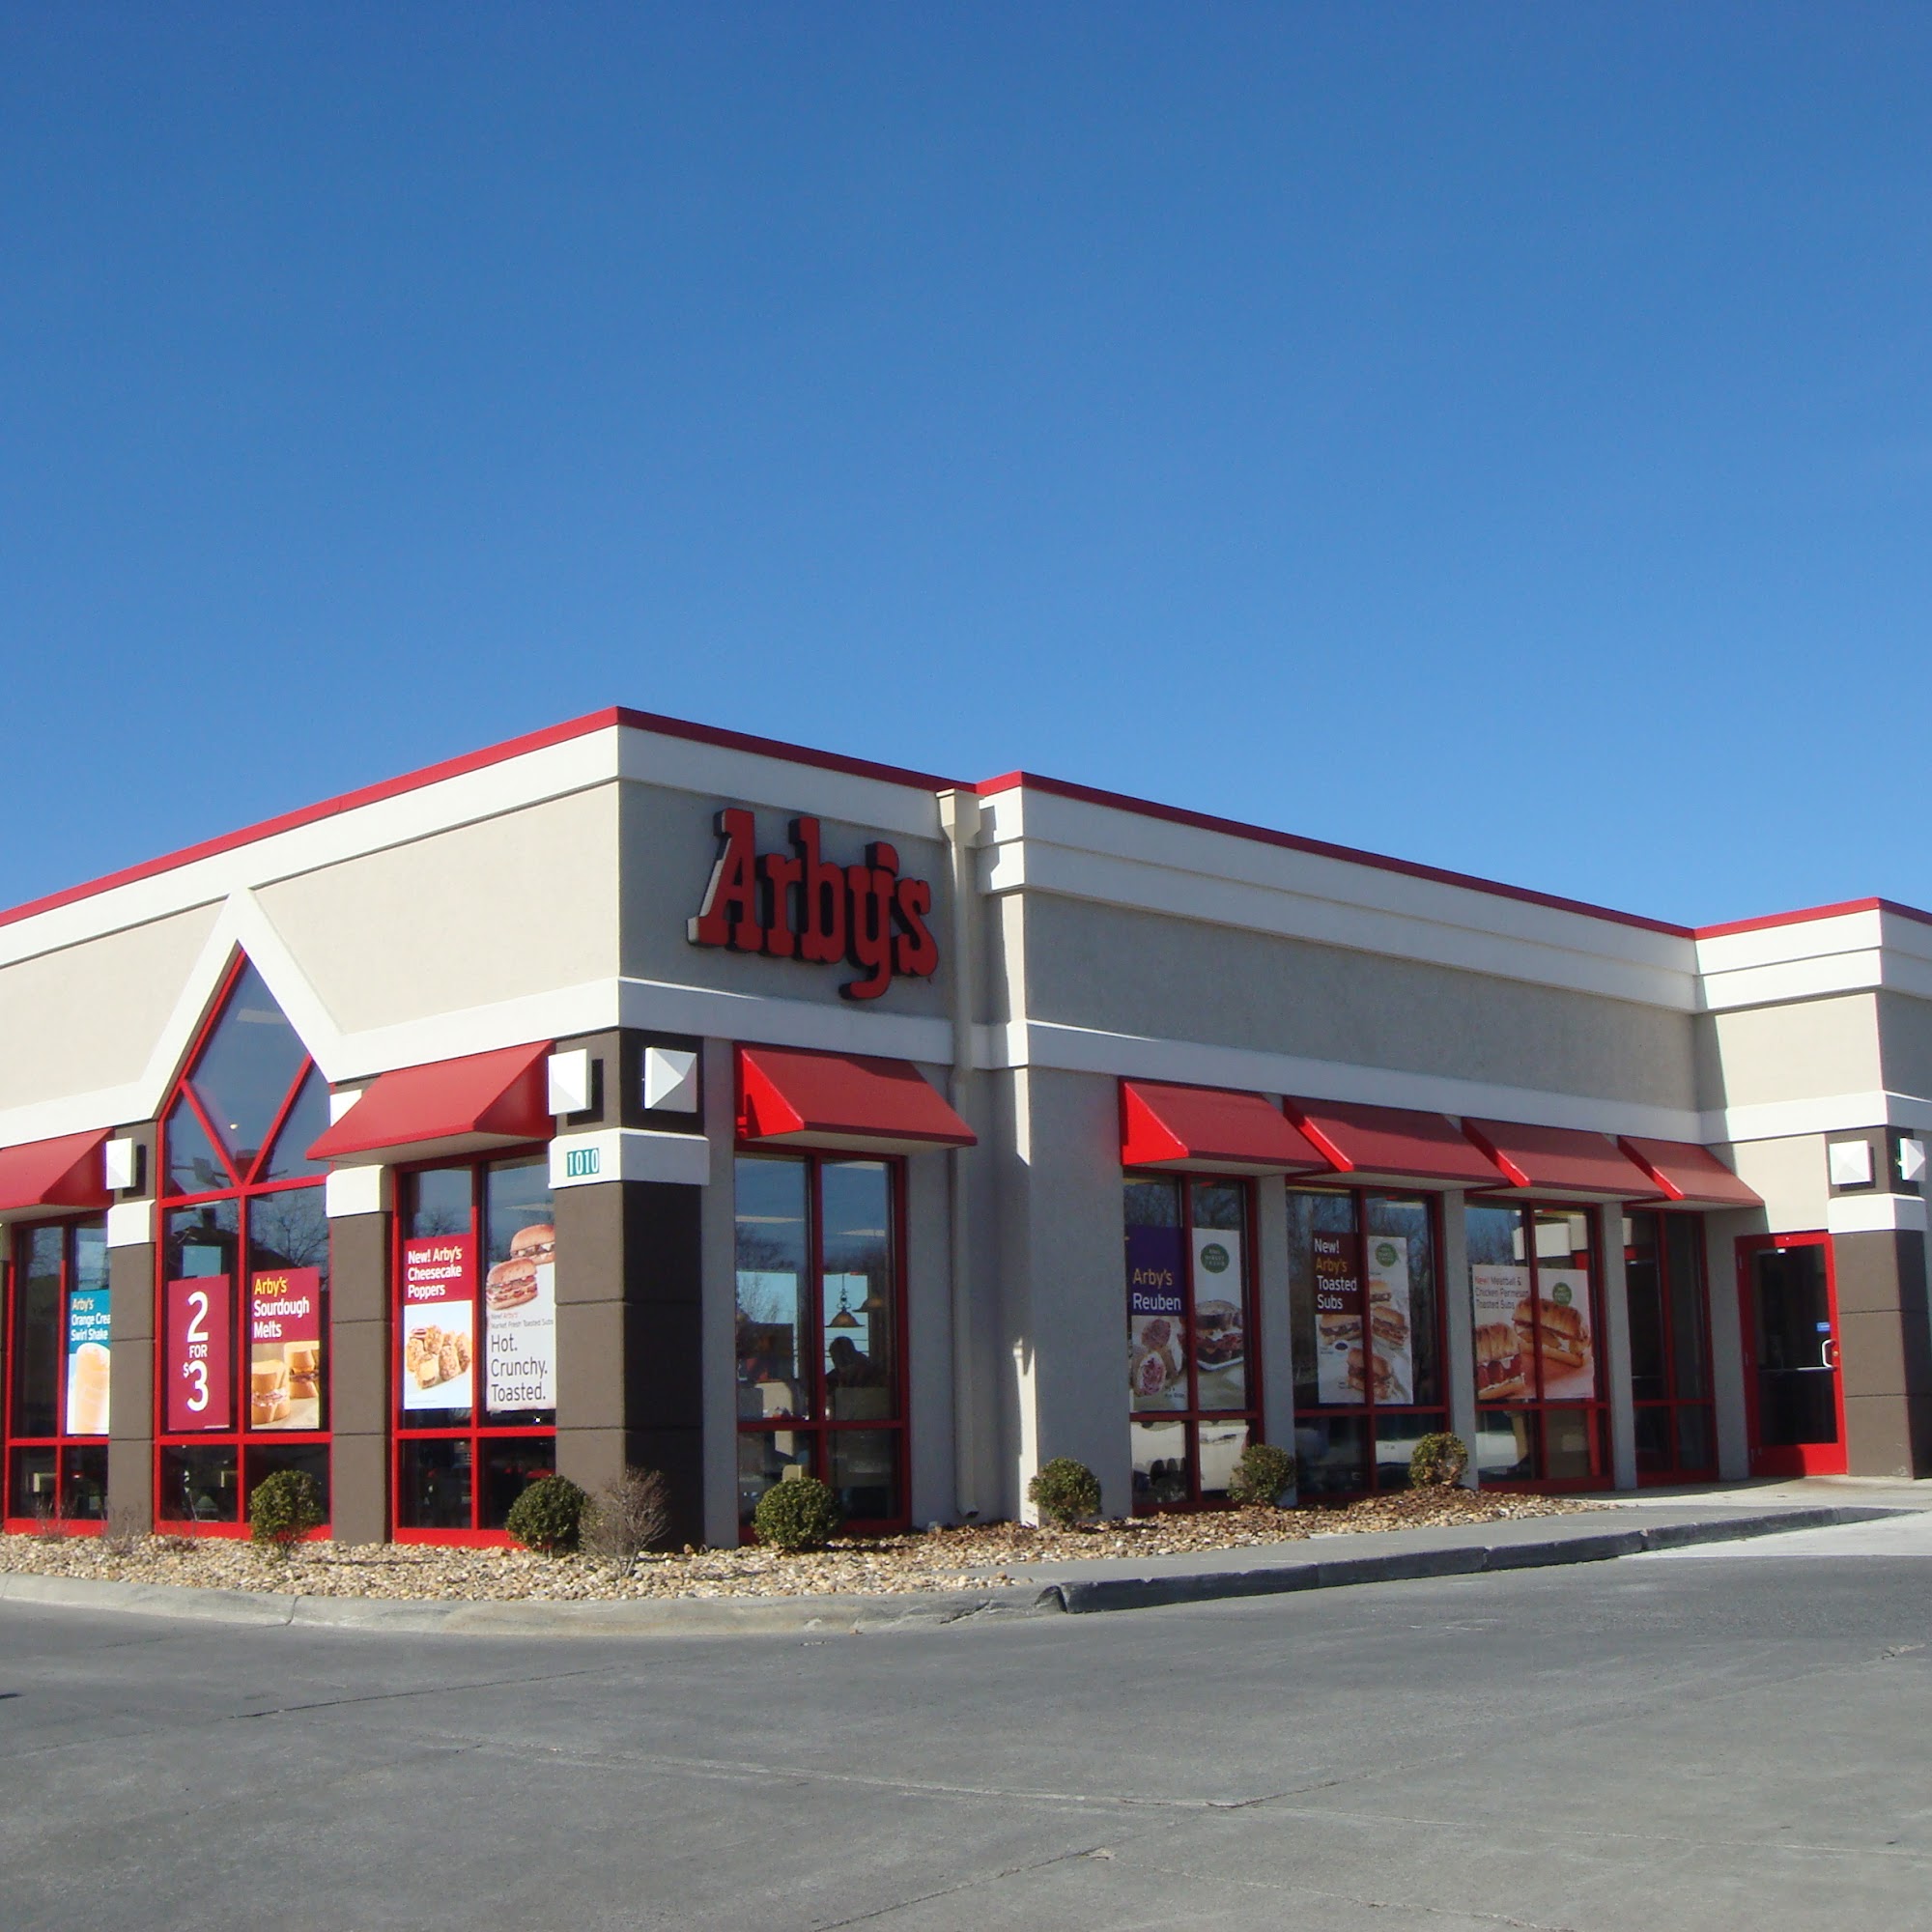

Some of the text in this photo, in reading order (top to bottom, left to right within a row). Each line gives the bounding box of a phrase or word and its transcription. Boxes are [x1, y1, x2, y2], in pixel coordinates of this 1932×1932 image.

[687, 808, 939, 1000] Arby's
[568, 1149, 599, 1176] 1010
[408, 1246, 463, 1264] New! Arby's
[1314, 1238, 1339, 1254] New!
[408, 1264, 463, 1281] Cheesecake
[1316, 1257, 1348, 1274] Arby's
[254, 1276, 288, 1297] Arby's
[1133, 1267, 1173, 1290] Arby's
[1317, 1275, 1357, 1292] Toasted
[408, 1284, 446, 1299] Poppers
[71, 1298, 94, 1312] Arby's
[253, 1296, 310, 1318] Sourdough
[1133, 1293, 1181, 1311] Reuben
[1317, 1293, 1344, 1309] Subs
[71, 1314, 95, 1327] Orange
[186, 1291, 209, 1343] 2
[71, 1328, 108, 1341] Swirl Shake
[253, 1321, 282, 1339] Melts
[188, 1344, 208, 1358] FOR
[491, 1333, 518, 1352] Hot.
[491, 1356, 548, 1379] Crunchy.
[491, 1381, 546, 1402] Toasted.
